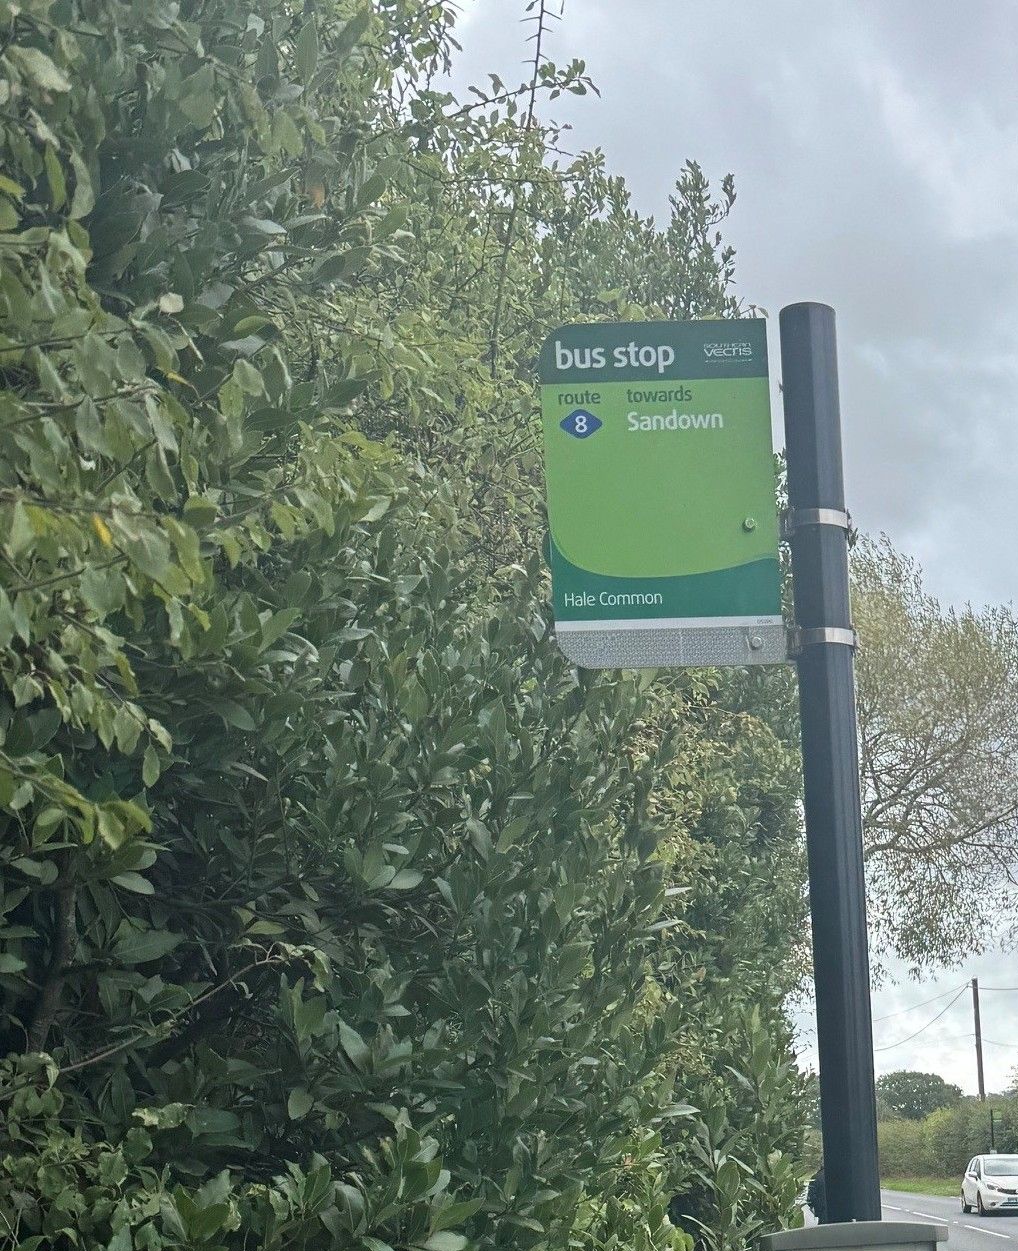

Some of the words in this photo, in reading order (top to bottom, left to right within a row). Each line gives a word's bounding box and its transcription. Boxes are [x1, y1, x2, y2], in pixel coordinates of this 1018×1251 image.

[555, 341, 605, 370] bus
[613, 342, 675, 373] stop
[558, 390, 601, 406] route
[626, 386, 693, 403] towards
[575, 415, 587, 433] 8
[627, 409, 724, 432] Sandown
[564, 592, 596, 608] Hale
[599, 590, 663, 607] Common
